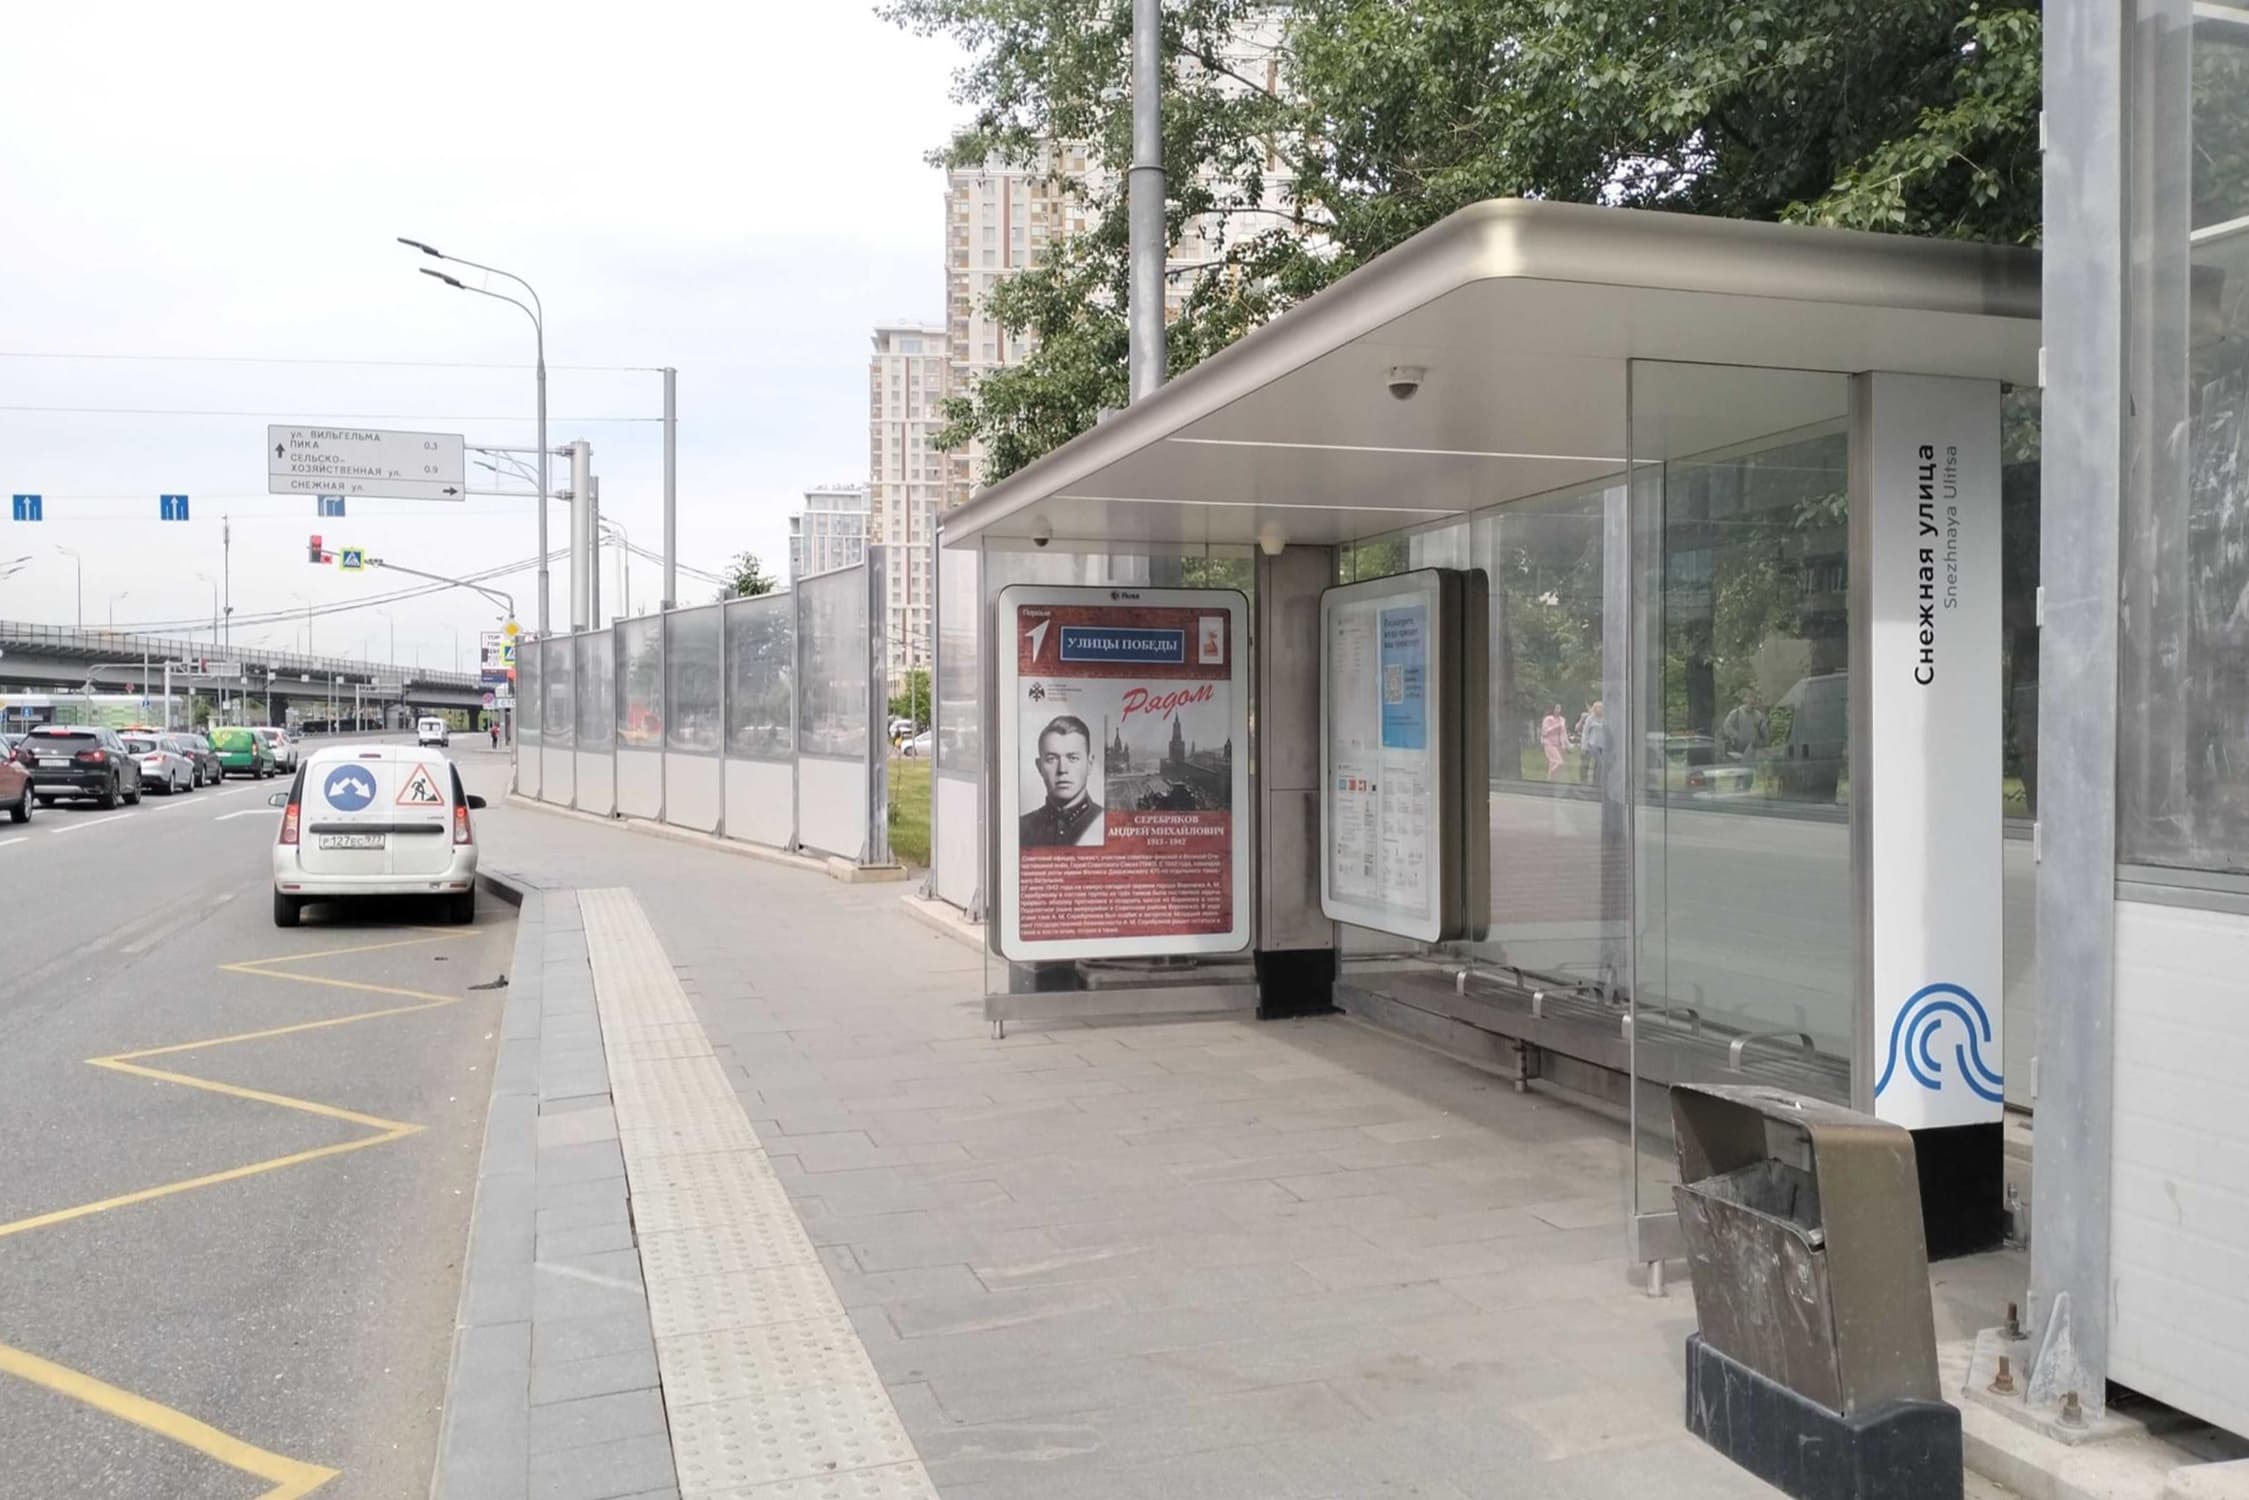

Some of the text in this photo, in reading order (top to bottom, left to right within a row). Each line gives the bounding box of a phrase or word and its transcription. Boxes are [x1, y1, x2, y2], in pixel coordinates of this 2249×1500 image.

[310, 430, 381, 441] ВИЛЬГЕЛЬМА
[290, 440, 319, 449] ПИКА
[290, 463, 382, 476] ХОЗЯЙСТВЕННАЯ
[290, 480, 345, 490] СНЕЖНАЯ
[1943, 445, 1961, 609] Snezhnaya Ulitsa
[1914, 444, 1938, 686] Снежная улица
[1067, 637, 1178, 651] УЛИЦЫ ПОБЕДЫ
[1120, 683, 1214, 722] Рядом
[1134, 814, 1199, 825] СЕРЕБРЯКОВ
[1107, 825, 1225, 837] АНДРЕЙ МИХАЙЛОВИЧ
